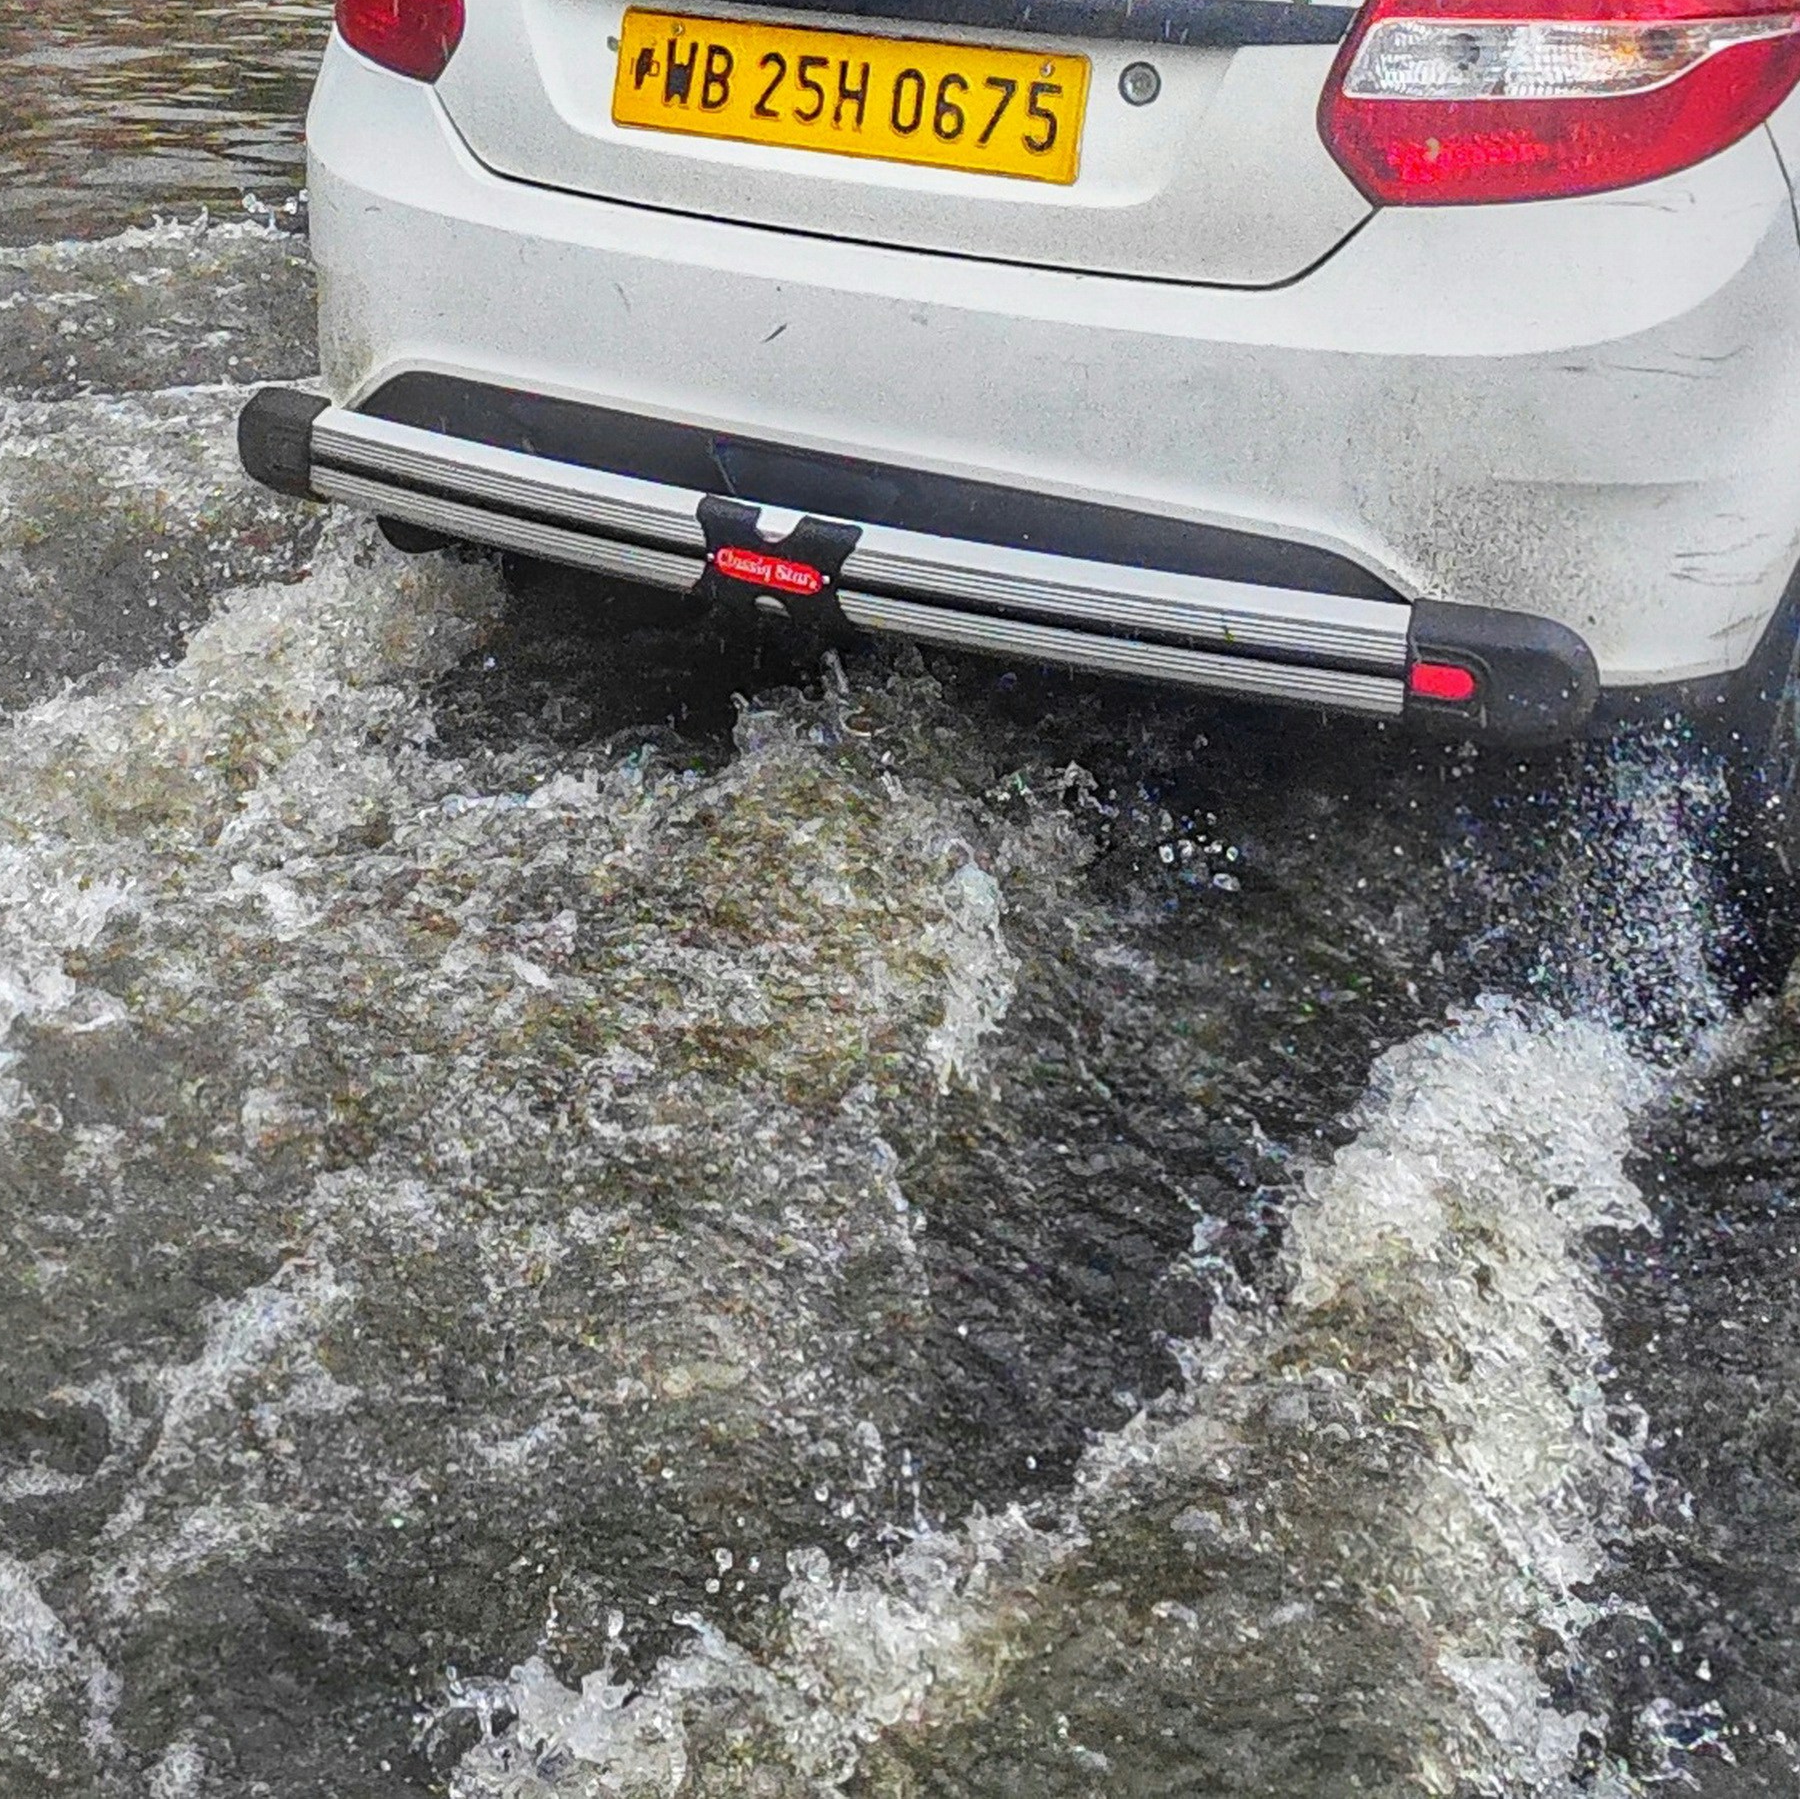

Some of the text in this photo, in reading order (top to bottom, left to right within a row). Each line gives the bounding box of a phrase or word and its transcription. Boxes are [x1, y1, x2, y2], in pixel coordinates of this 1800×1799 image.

[661, 37, 1063, 156] WB 25H 0675
